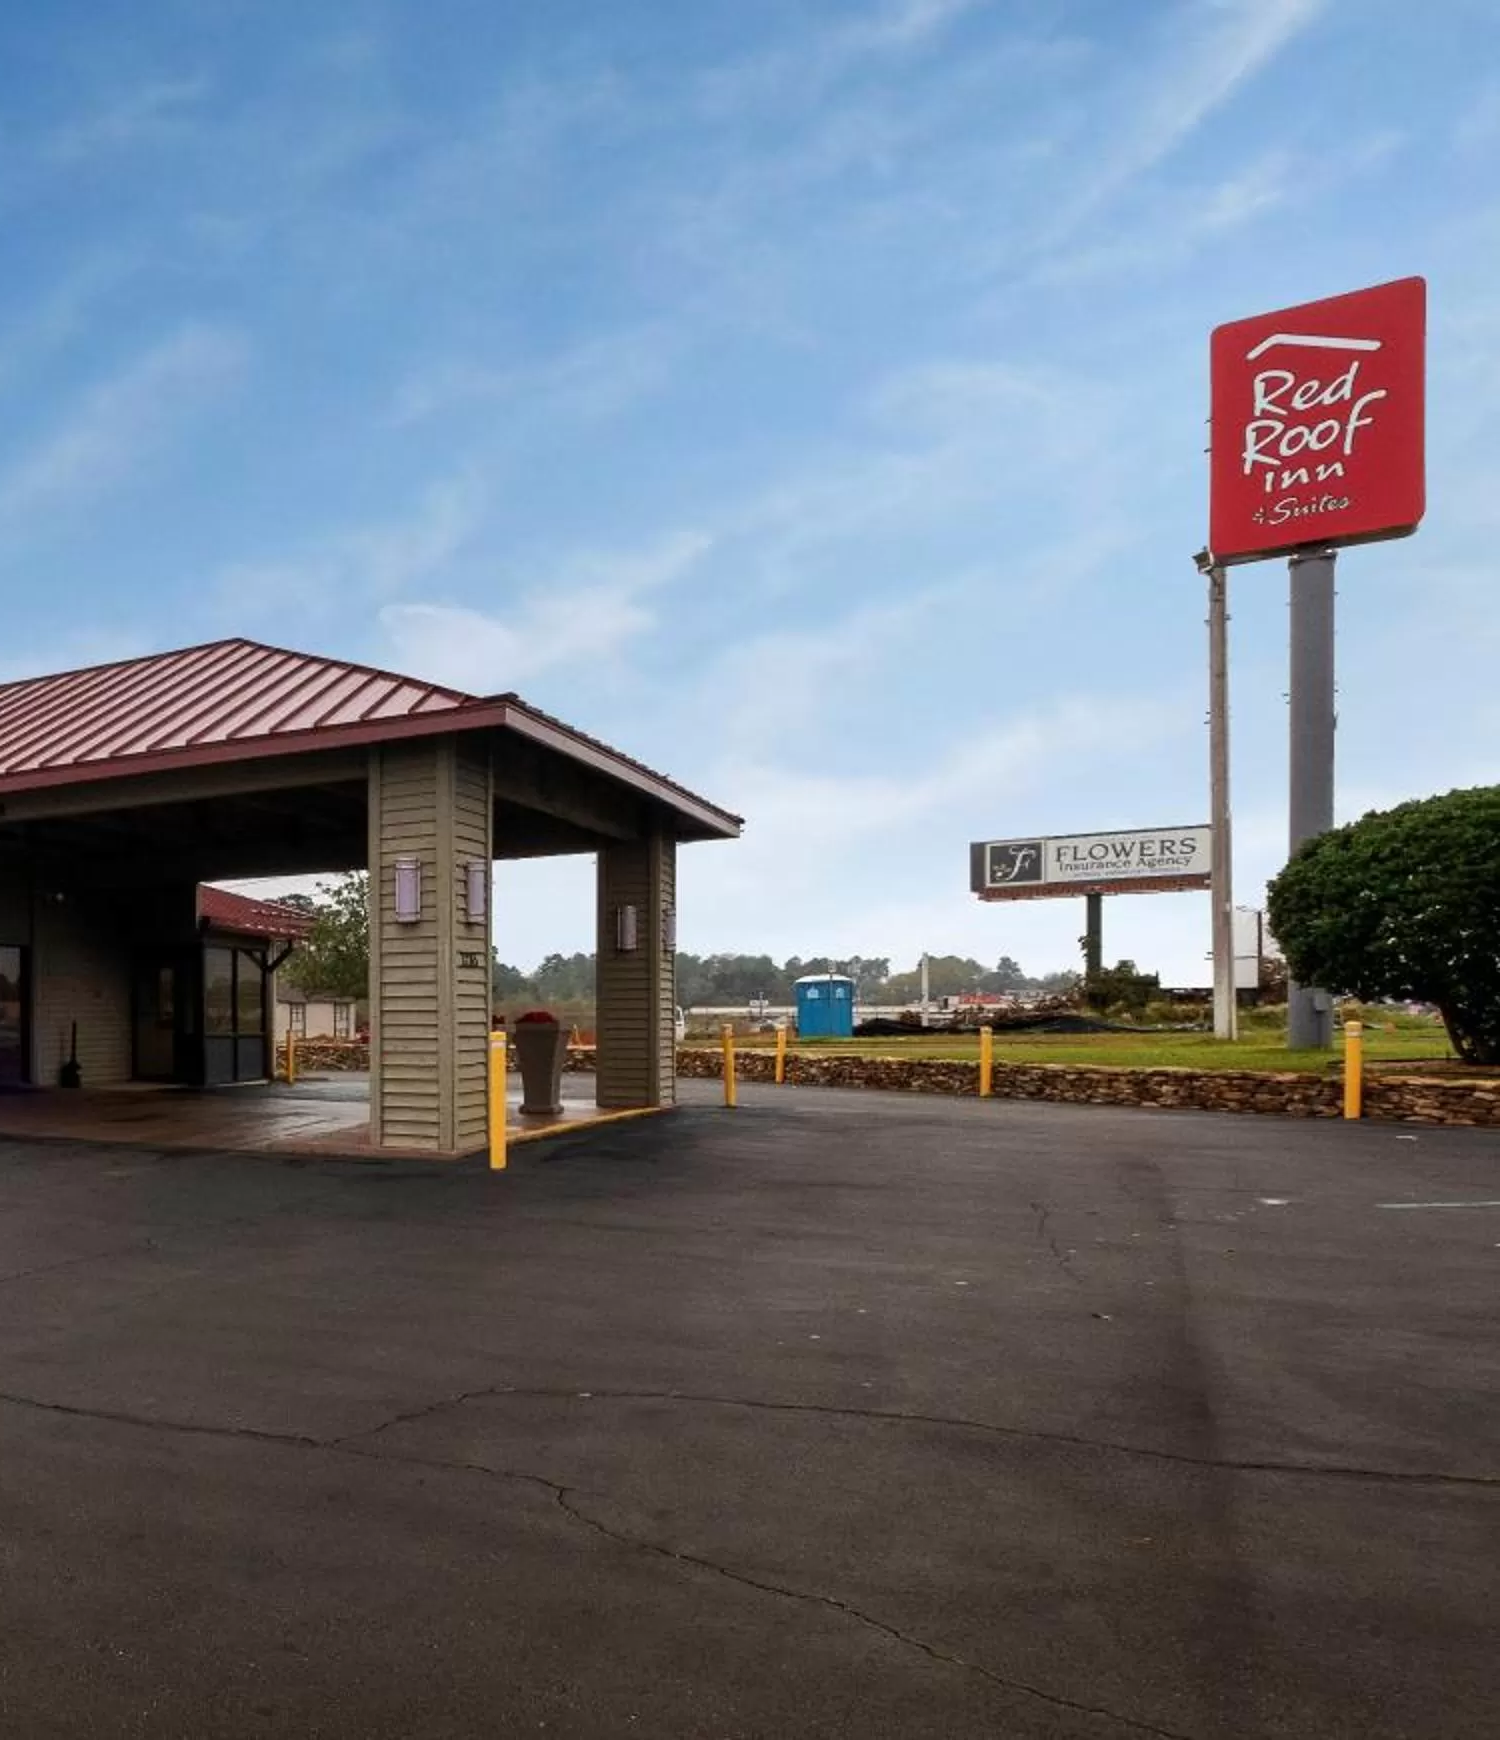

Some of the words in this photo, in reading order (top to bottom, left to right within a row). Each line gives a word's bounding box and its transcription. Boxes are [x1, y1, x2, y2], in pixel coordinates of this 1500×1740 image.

[1253, 360, 1360, 417] Red
[1241, 389, 1388, 475] Roof
[1269, 493, 1349, 525] Suites
[1055, 837, 1197, 863] FLOWERS
[1059, 858, 1132, 872] Insurance
[1136, 856, 1194, 868] Agency
